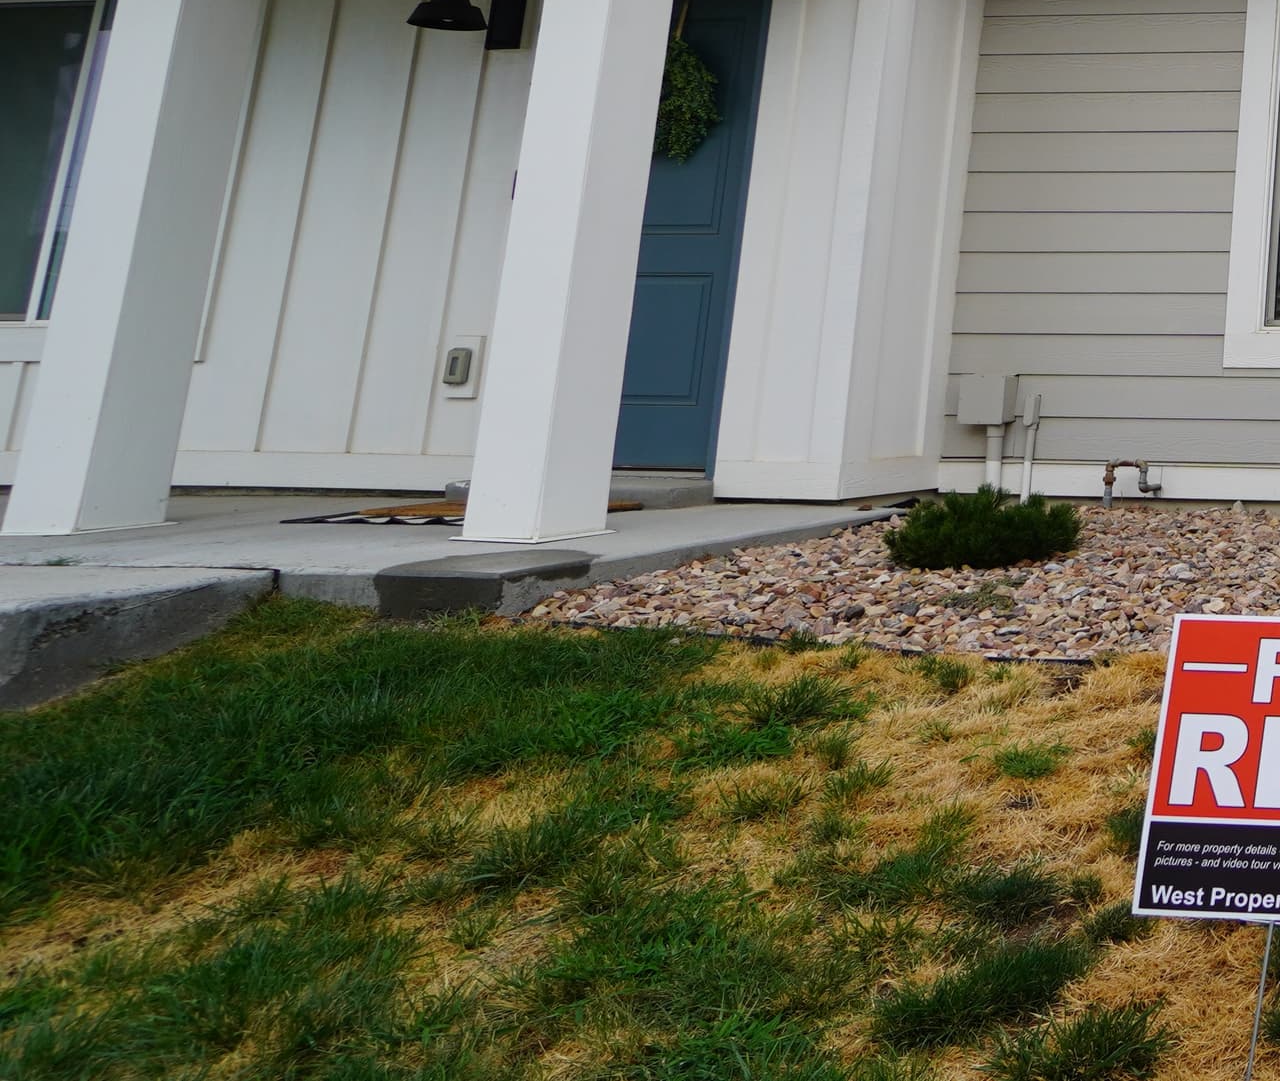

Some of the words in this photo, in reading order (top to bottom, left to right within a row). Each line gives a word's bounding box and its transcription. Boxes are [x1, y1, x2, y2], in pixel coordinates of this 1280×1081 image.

[1157, 840, 1172, 851] For
[1175, 843, 1200, 852] more
[1202, 844, 1242, 856] property
[1243, 845, 1277, 856] details
[1154, 855, 1192, 867] pictures
[1201, 855, 1221, 868] and
[1222, 857, 1248, 869] video
[1251, 859, 1270, 870] tour
[1151, 885, 1204, 905] West
